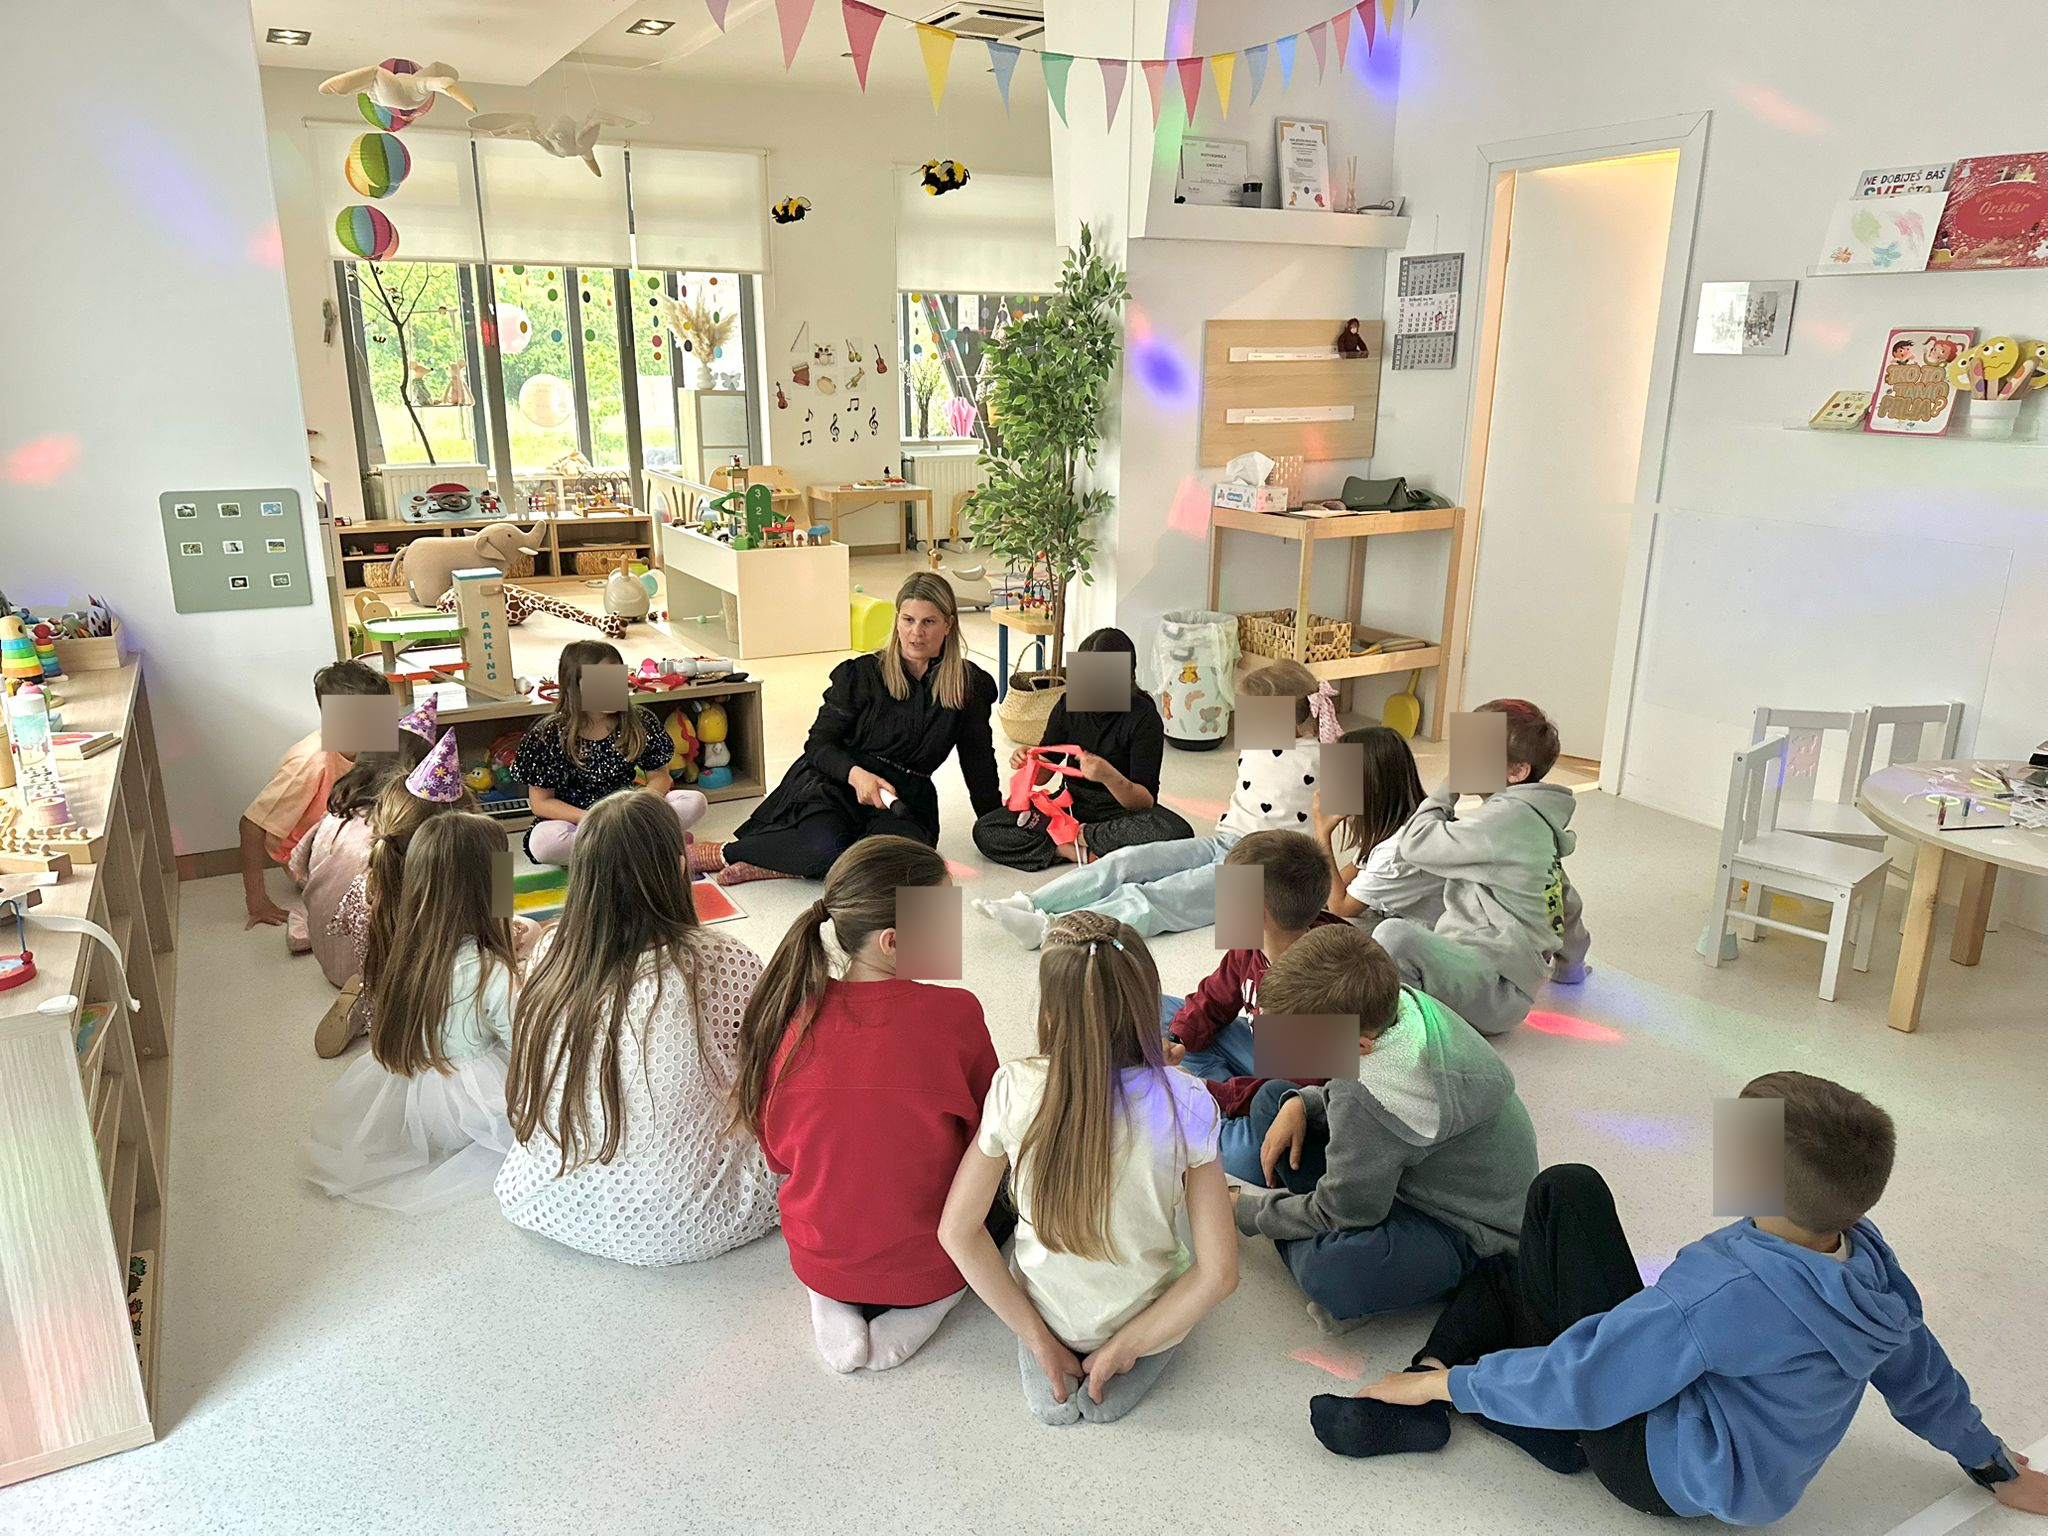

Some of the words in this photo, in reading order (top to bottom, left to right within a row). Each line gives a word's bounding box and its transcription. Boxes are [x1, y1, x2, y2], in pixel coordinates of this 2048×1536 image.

[1863, 176, 1878, 186] NE
[1880, 169, 1923, 184] DOBIJEŠ
[1925, 167, 1947, 180] BAŠ
[1979, 200, 2031, 216] Orašar
[1887, 365, 1920, 384] TKO
[1921, 365, 1945, 383] TO
[1894, 382, 1949, 401] TAMO
[754, 488, 762, 498] 3
[756, 506, 762, 516] 2
[480, 611, 497, 680] PARKING
